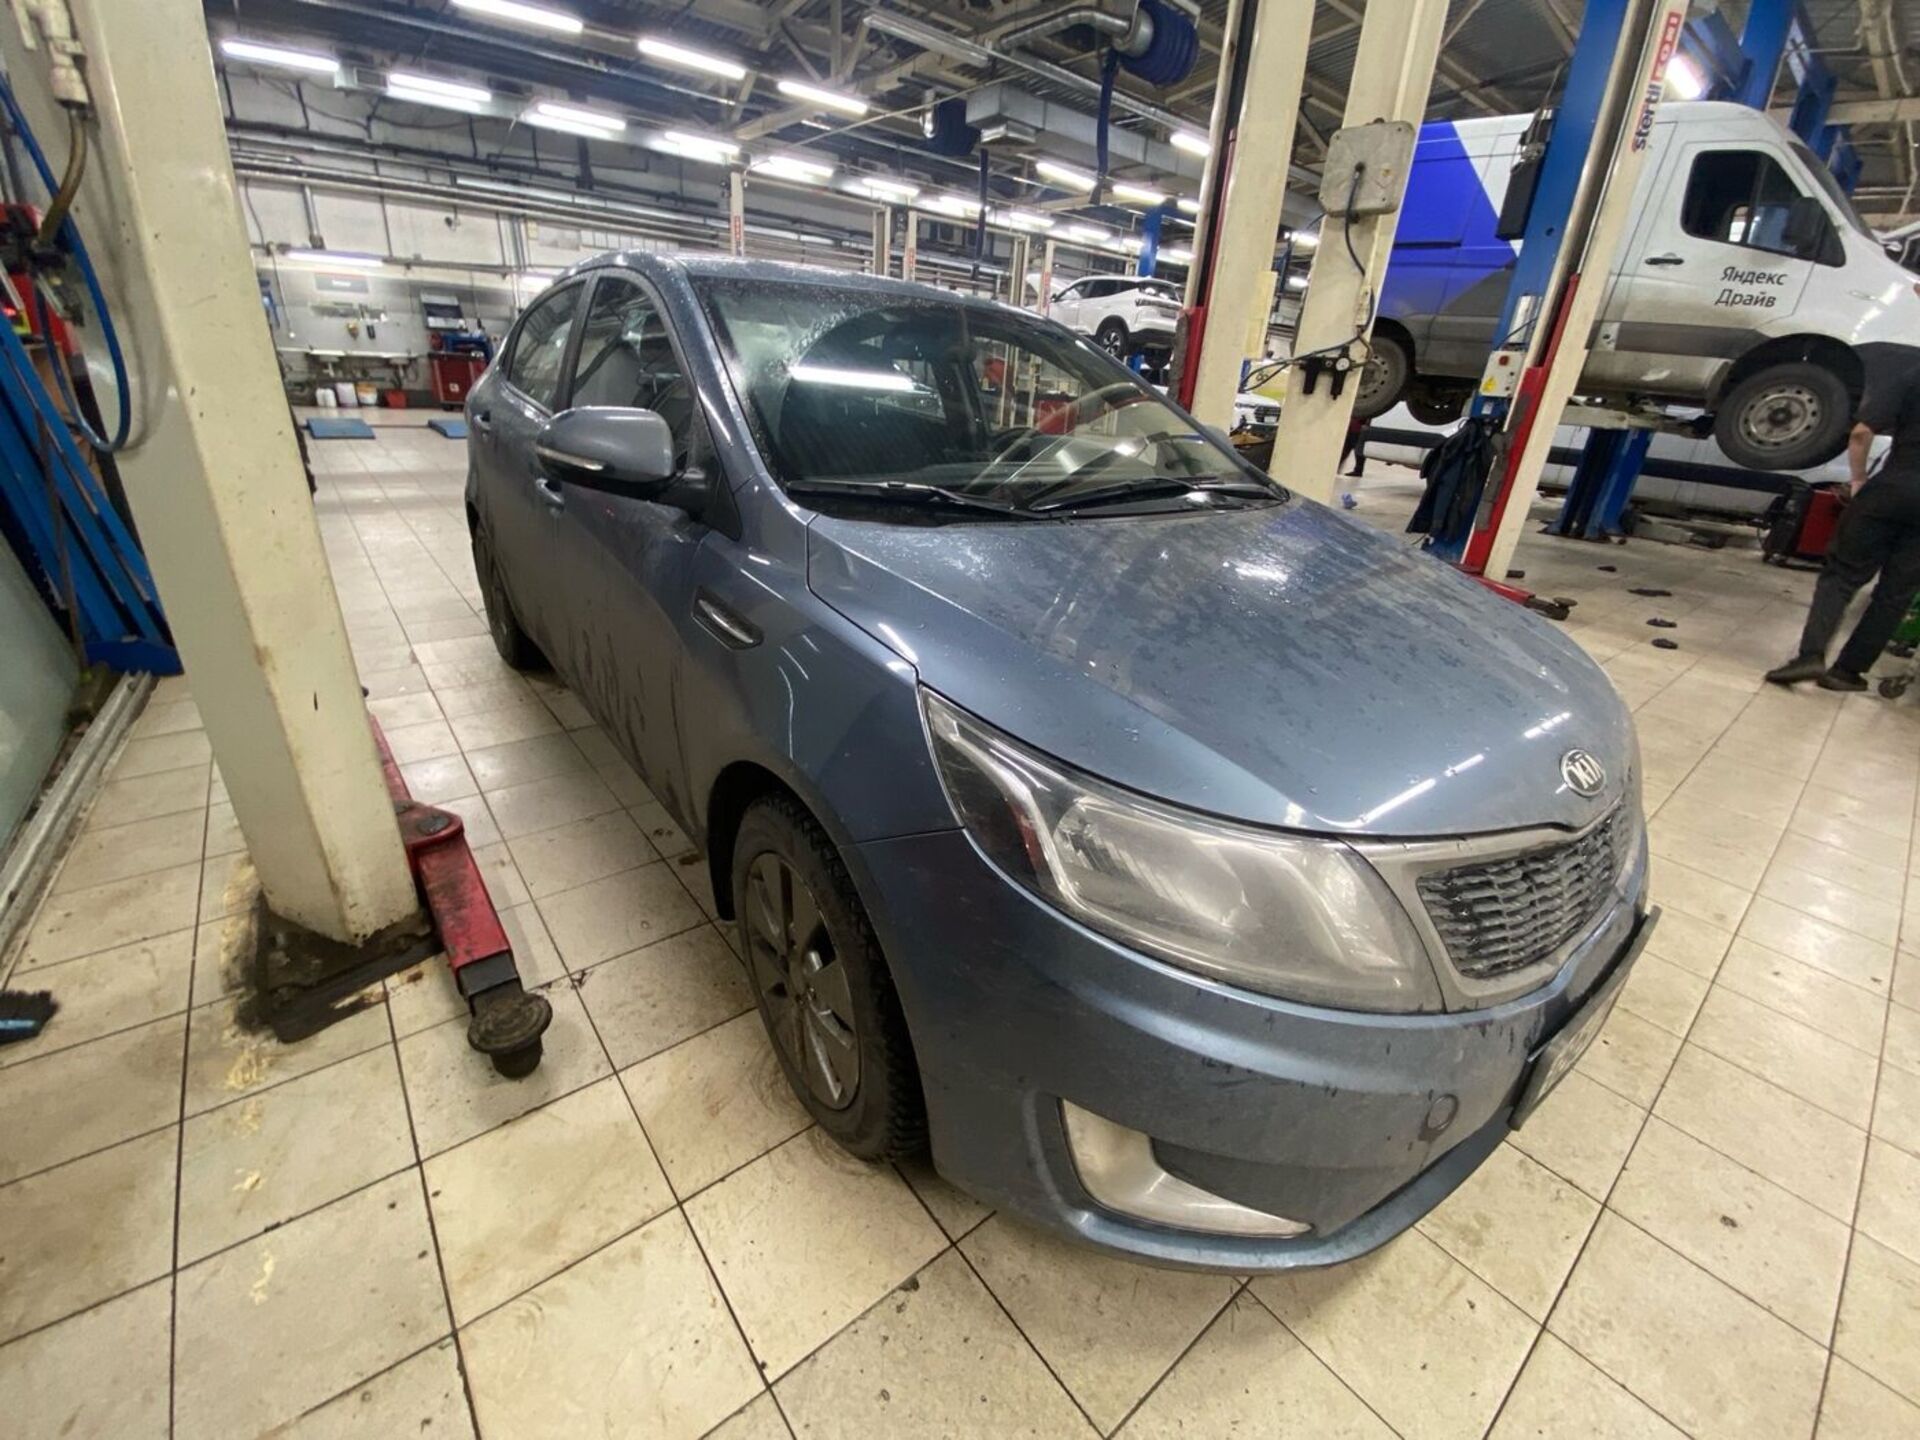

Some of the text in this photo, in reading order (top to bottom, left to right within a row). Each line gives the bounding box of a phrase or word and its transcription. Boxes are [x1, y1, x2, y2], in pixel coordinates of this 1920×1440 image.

[1632, 84, 1661, 151] stertil
[1720, 266, 1788, 285] Яндекс
[1714, 288, 1776, 308] Драйв
[1566, 753, 1602, 790] KIA
